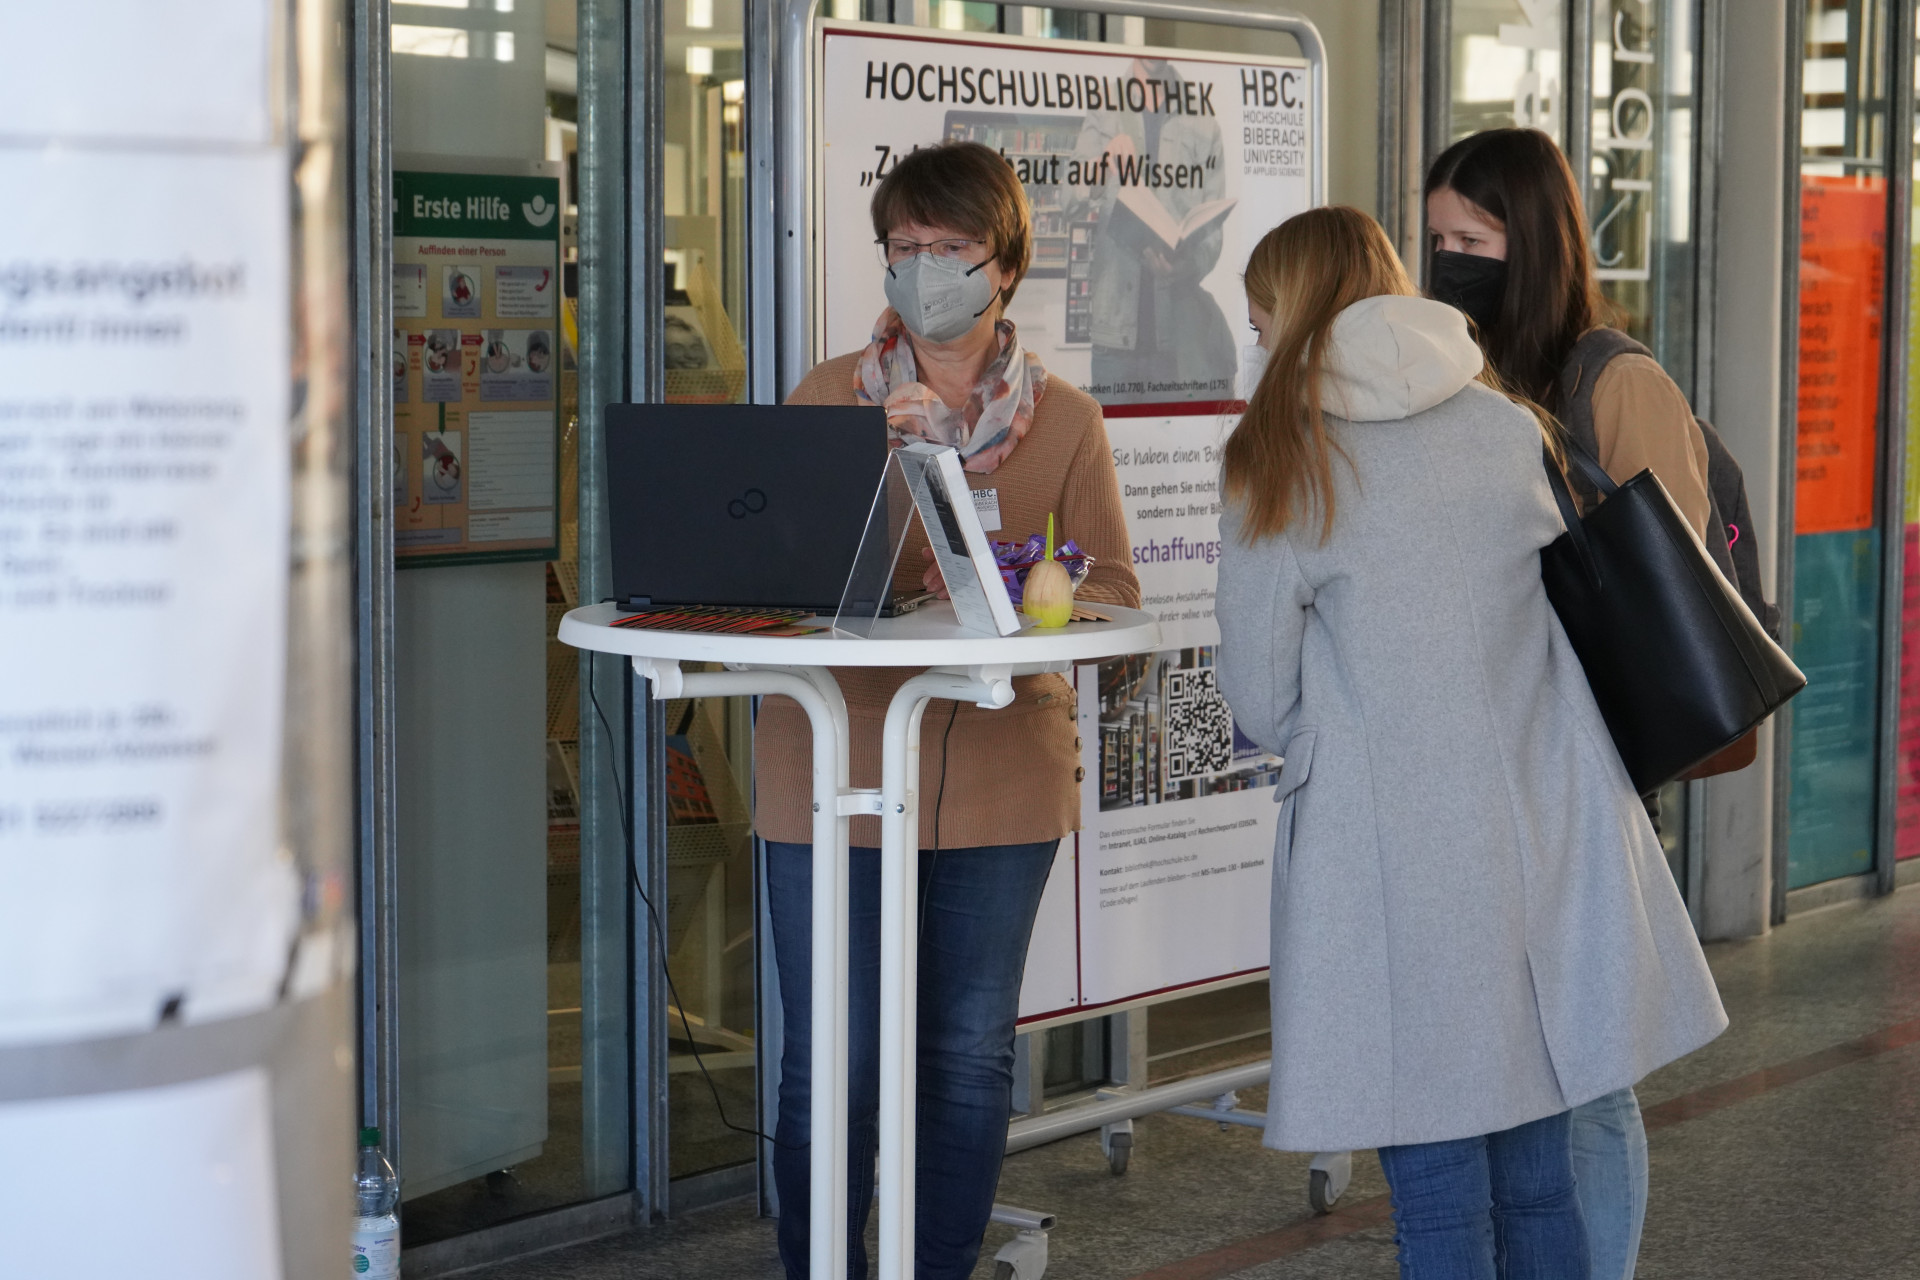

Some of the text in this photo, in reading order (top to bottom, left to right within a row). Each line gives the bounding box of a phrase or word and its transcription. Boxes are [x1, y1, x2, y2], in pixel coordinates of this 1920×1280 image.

[865, 60, 1216, 117] HOCHSCHULBIBLIOTHEK
[1241, 68, 1304, 109] HBC.
[1243, 110, 1304, 127] HOCHSCHULE
[1243, 126, 1305, 147] BIBERACH
[1592, 0, 1654, 281] Libr
[1243, 148, 1305, 165] UNIVERSITY
[1068, 154, 1109, 187] auf
[413, 194, 510, 221] Erste Hilfe
[418, 244, 507, 257] Auffinden einer Person
[1147, 379, 1208, 393] Fachzeitschriften
[1112, 448, 1130, 467] Sie
[1134, 445, 1169, 466] haben
[1173, 447, 1200, 463] einen
[1125, 479, 1216, 498] Dann gehen Sie nicht
[1137, 504, 1173, 520] sondern
[1176, 507, 1185, 517] zu
[1188, 503, 1208, 517] Ihrer
[1100, 830, 1110, 839] Das
[1100, 886, 1118, 895] Immer
